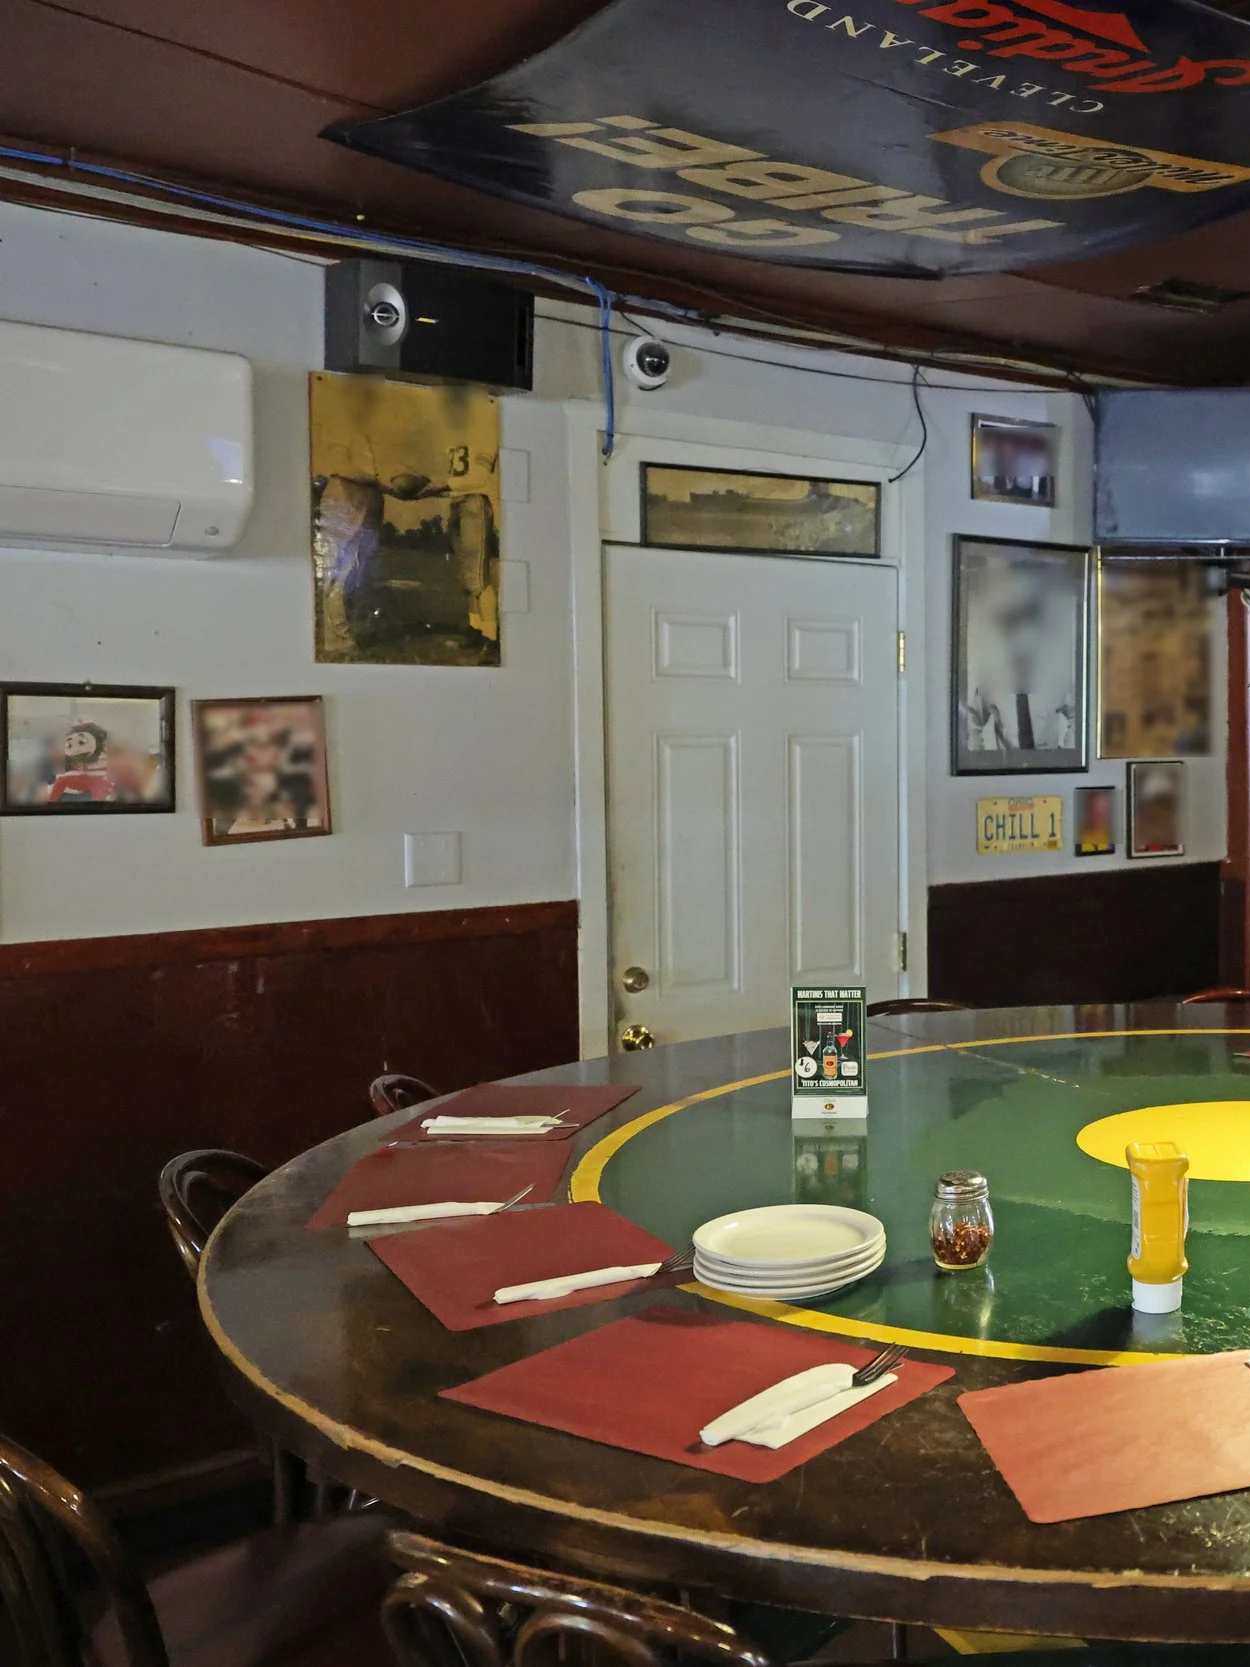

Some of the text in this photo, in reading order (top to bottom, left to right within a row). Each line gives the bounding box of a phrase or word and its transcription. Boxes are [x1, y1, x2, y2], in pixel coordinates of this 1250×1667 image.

[787, 0, 1105, 114] CLEVELAND
[503, 114, 1067, 244] TRIBE!
[571, 187, 841, 247] GO
[984, 811, 1057, 841] CHILL 1
[797, 990, 861, 999] MARTINIS THAT MATTER
[801, 1079, 859, 1087] TITO'S COSMOPOLITAN
